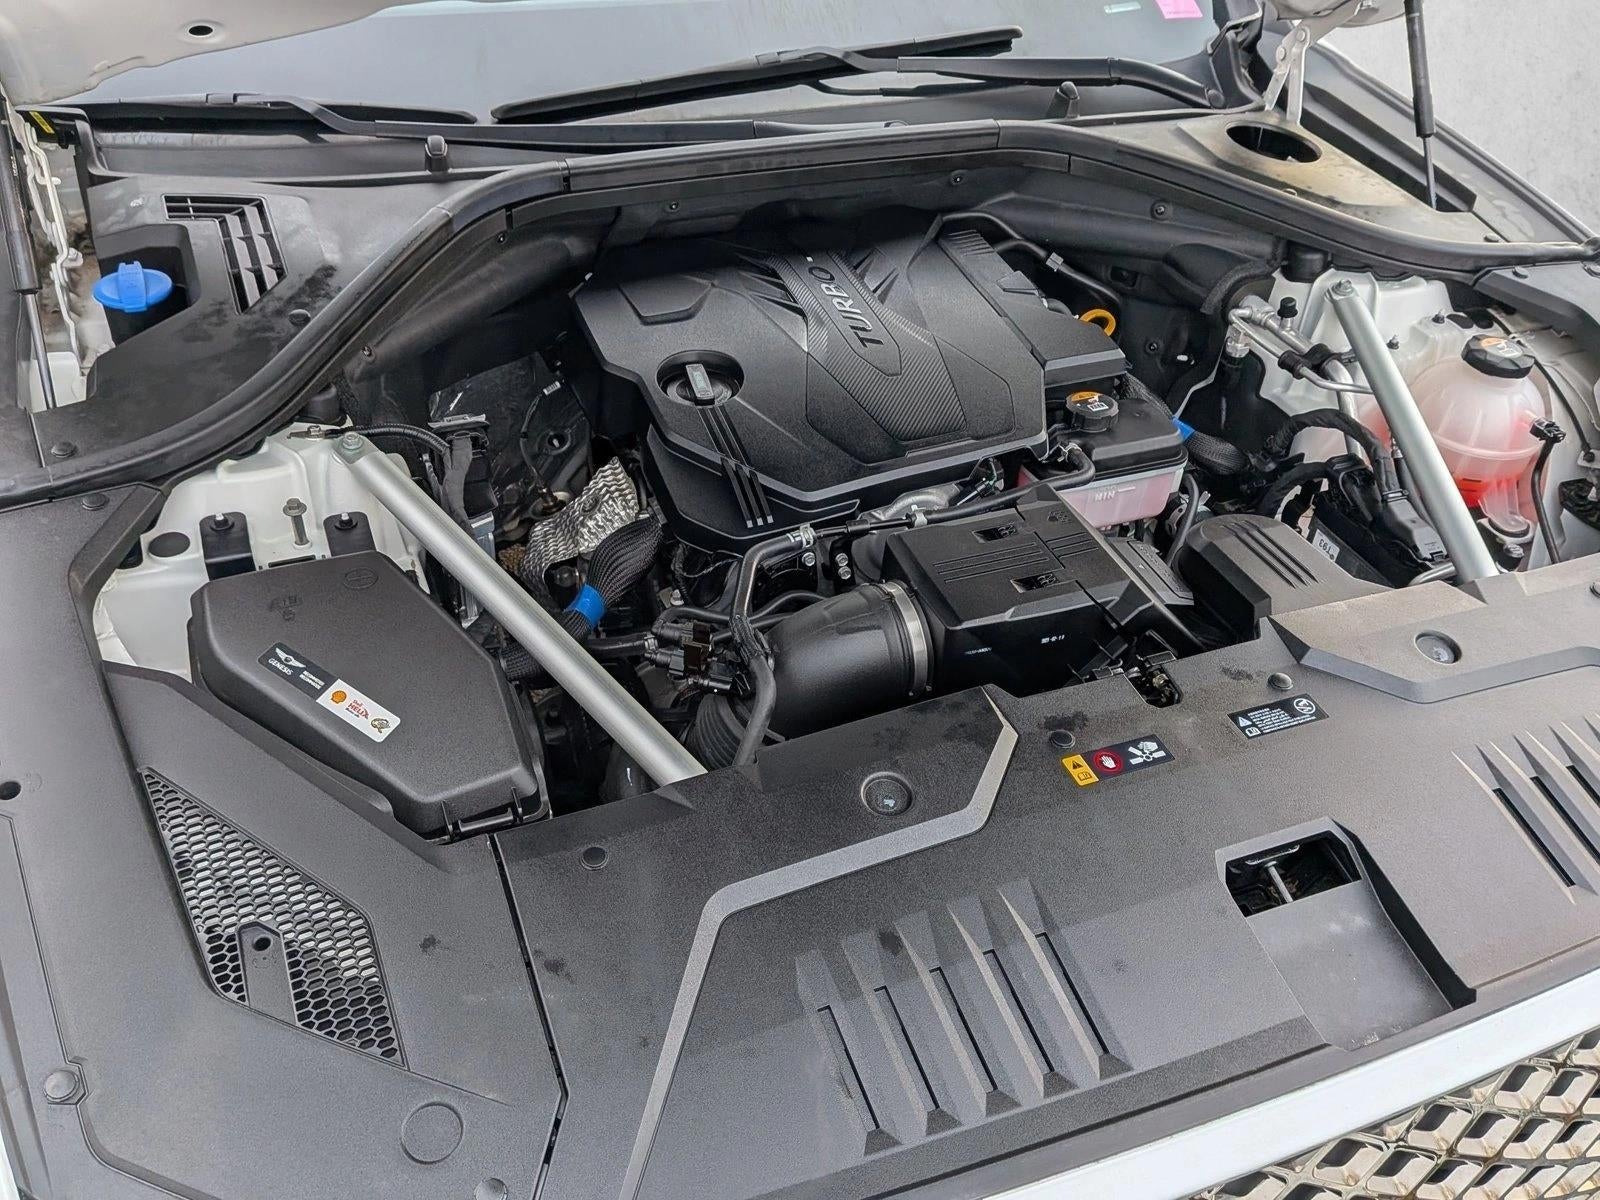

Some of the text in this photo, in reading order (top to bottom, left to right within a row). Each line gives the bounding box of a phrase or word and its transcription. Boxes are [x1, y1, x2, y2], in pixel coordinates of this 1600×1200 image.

[808, 266, 884, 348] TURBO
[268, 658, 294, 676] GENESIS
[347, 702, 369, 720] HELIX
